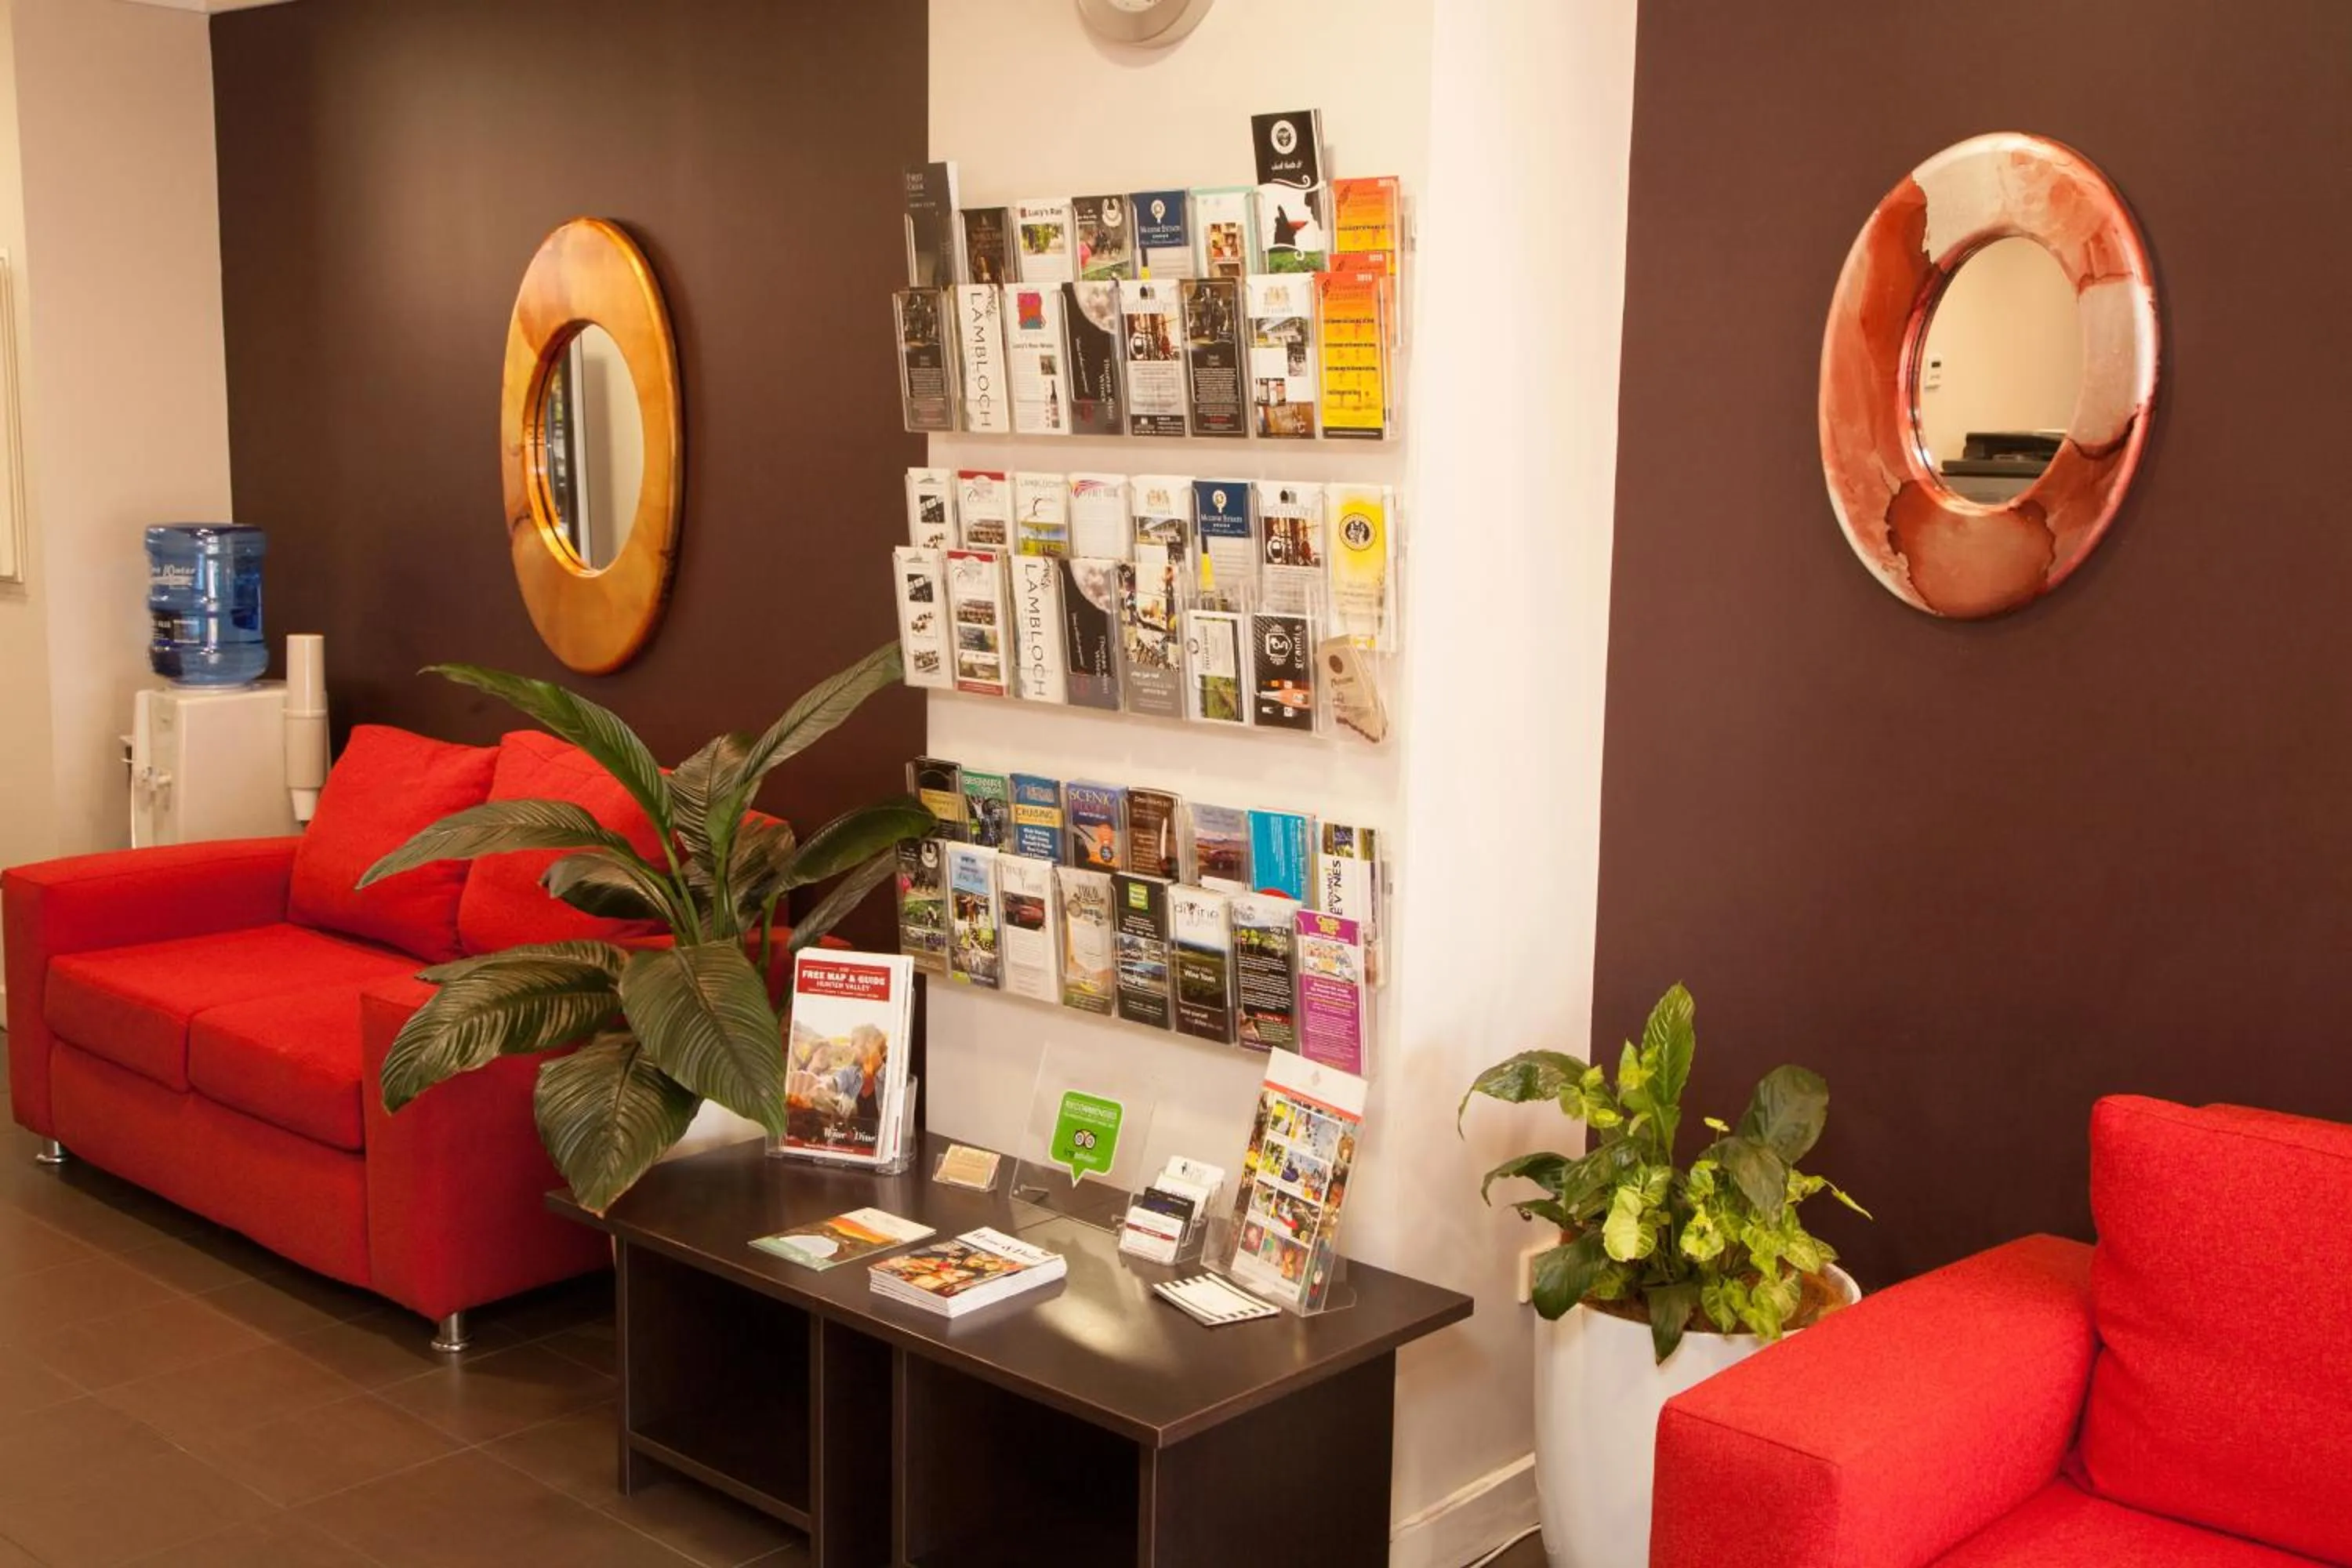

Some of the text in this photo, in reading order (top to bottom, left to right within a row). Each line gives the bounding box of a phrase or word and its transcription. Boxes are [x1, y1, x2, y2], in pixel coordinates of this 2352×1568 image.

[970, 292, 992, 427] LAMBLOCH
[1025, 563, 1047, 696] LAMBLOCH
[1334, 860, 1342, 904] VNES
[802, 969, 826, 979] FREE
[827, 971, 847, 982] MAP
[857, 975, 885, 985] GUIDE
[816, 980, 870, 992] HUNTER VALLEY
